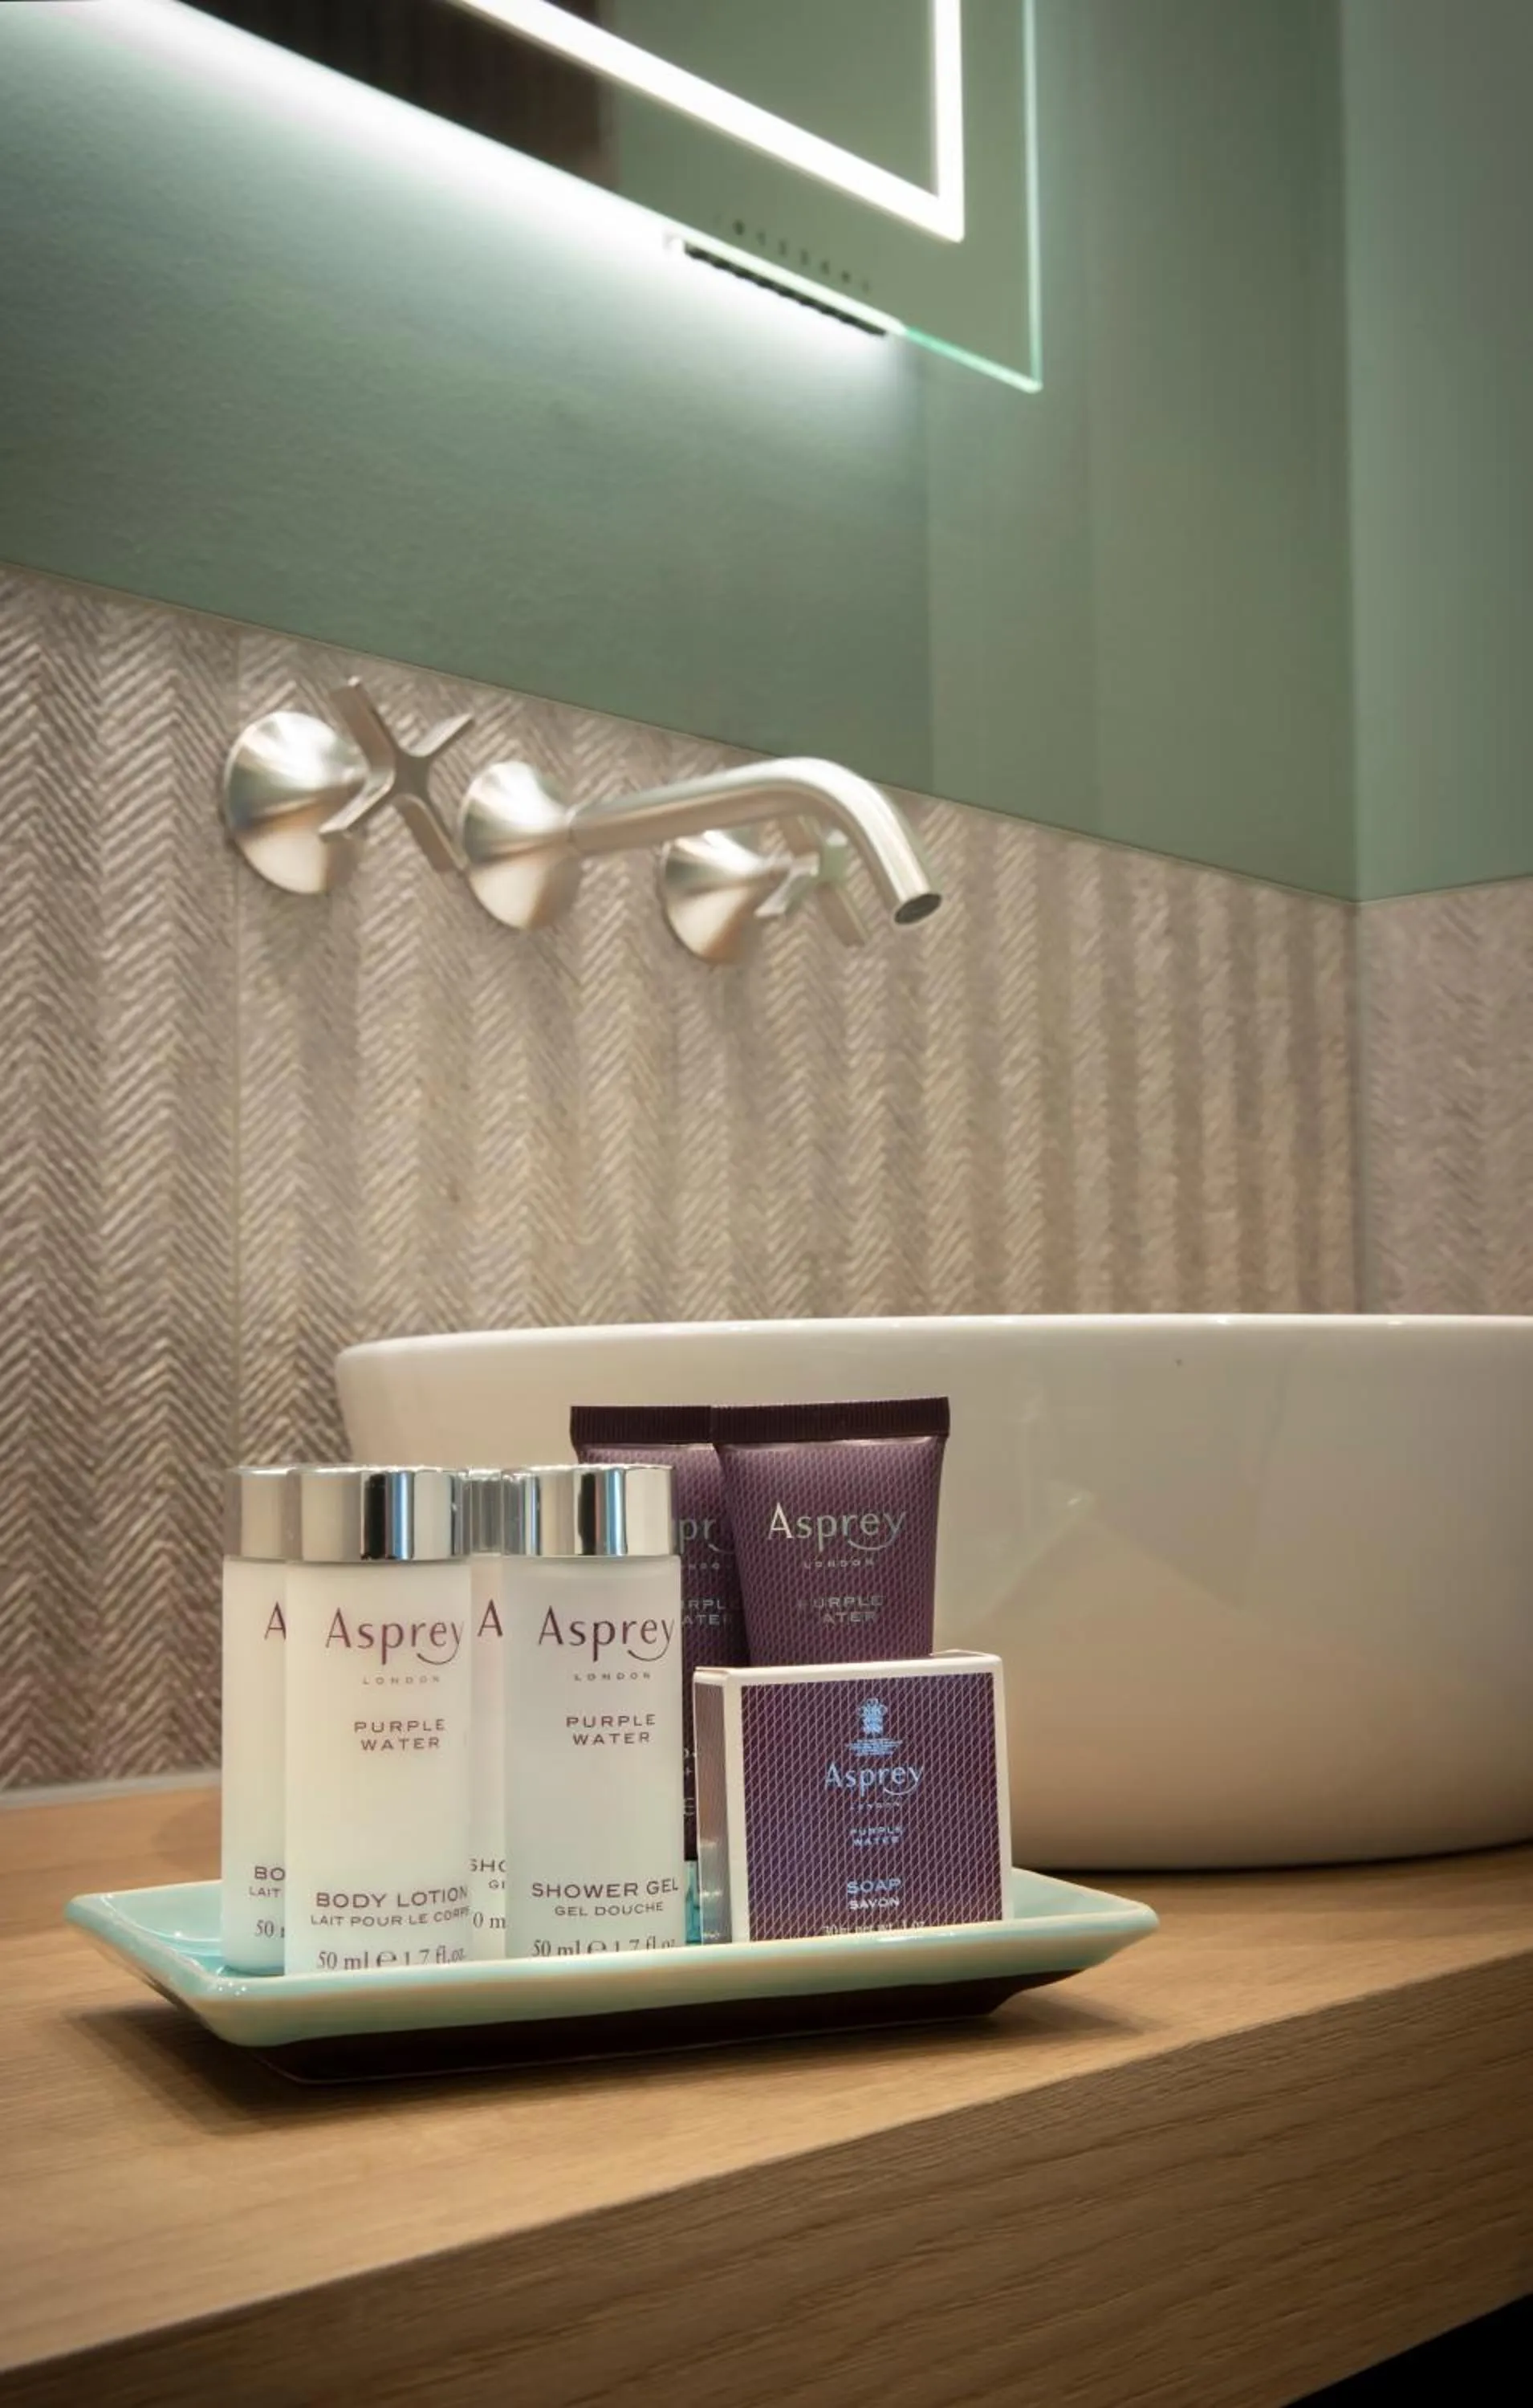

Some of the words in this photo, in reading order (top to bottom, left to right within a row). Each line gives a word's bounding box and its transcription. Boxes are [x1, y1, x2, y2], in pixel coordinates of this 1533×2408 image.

[768, 1502, 906, 1552] Asprey
[325, 1607, 464, 1666] Asprey
[538, 1605, 675, 1662] Asprey
[363, 1674, 441, 1685] LONDON
[575, 1672, 651, 1682] LONDON
[354, 1719, 445, 1733] PURPLE
[566, 1714, 656, 1728] PURPLE
[361, 1737, 441, 1751] WATER
[572, 1732, 650, 1746] WATER
[824, 1762, 924, 1797] Asprey
[254, 1865, 285, 1881] BO
[249, 1886, 282, 1898] LAIT
[531, 1882, 639, 1898] SHOWER
[646, 1877, 678, 1895] GEL
[847, 1877, 901, 1894] SOAP
[316, 1892, 387, 1909] BODY
[397, 1886, 469, 1908] LOTION
[849, 1897, 900, 1910] SAVON
[555, 1906, 588, 1917] GEL
[594, 1902, 664, 1917] DOUCHE
[311, 1914, 345, 1926] LAIT
[350, 1915, 402, 1927] POUR
[409, 1913, 428, 1926] LE
[255, 1919, 274, 1938] 50
[531, 1938, 551, 1957] 50
[557, 1939, 580, 1956] ml
[318, 1951, 338, 1970] 50
[344, 1951, 369, 1971] ml
